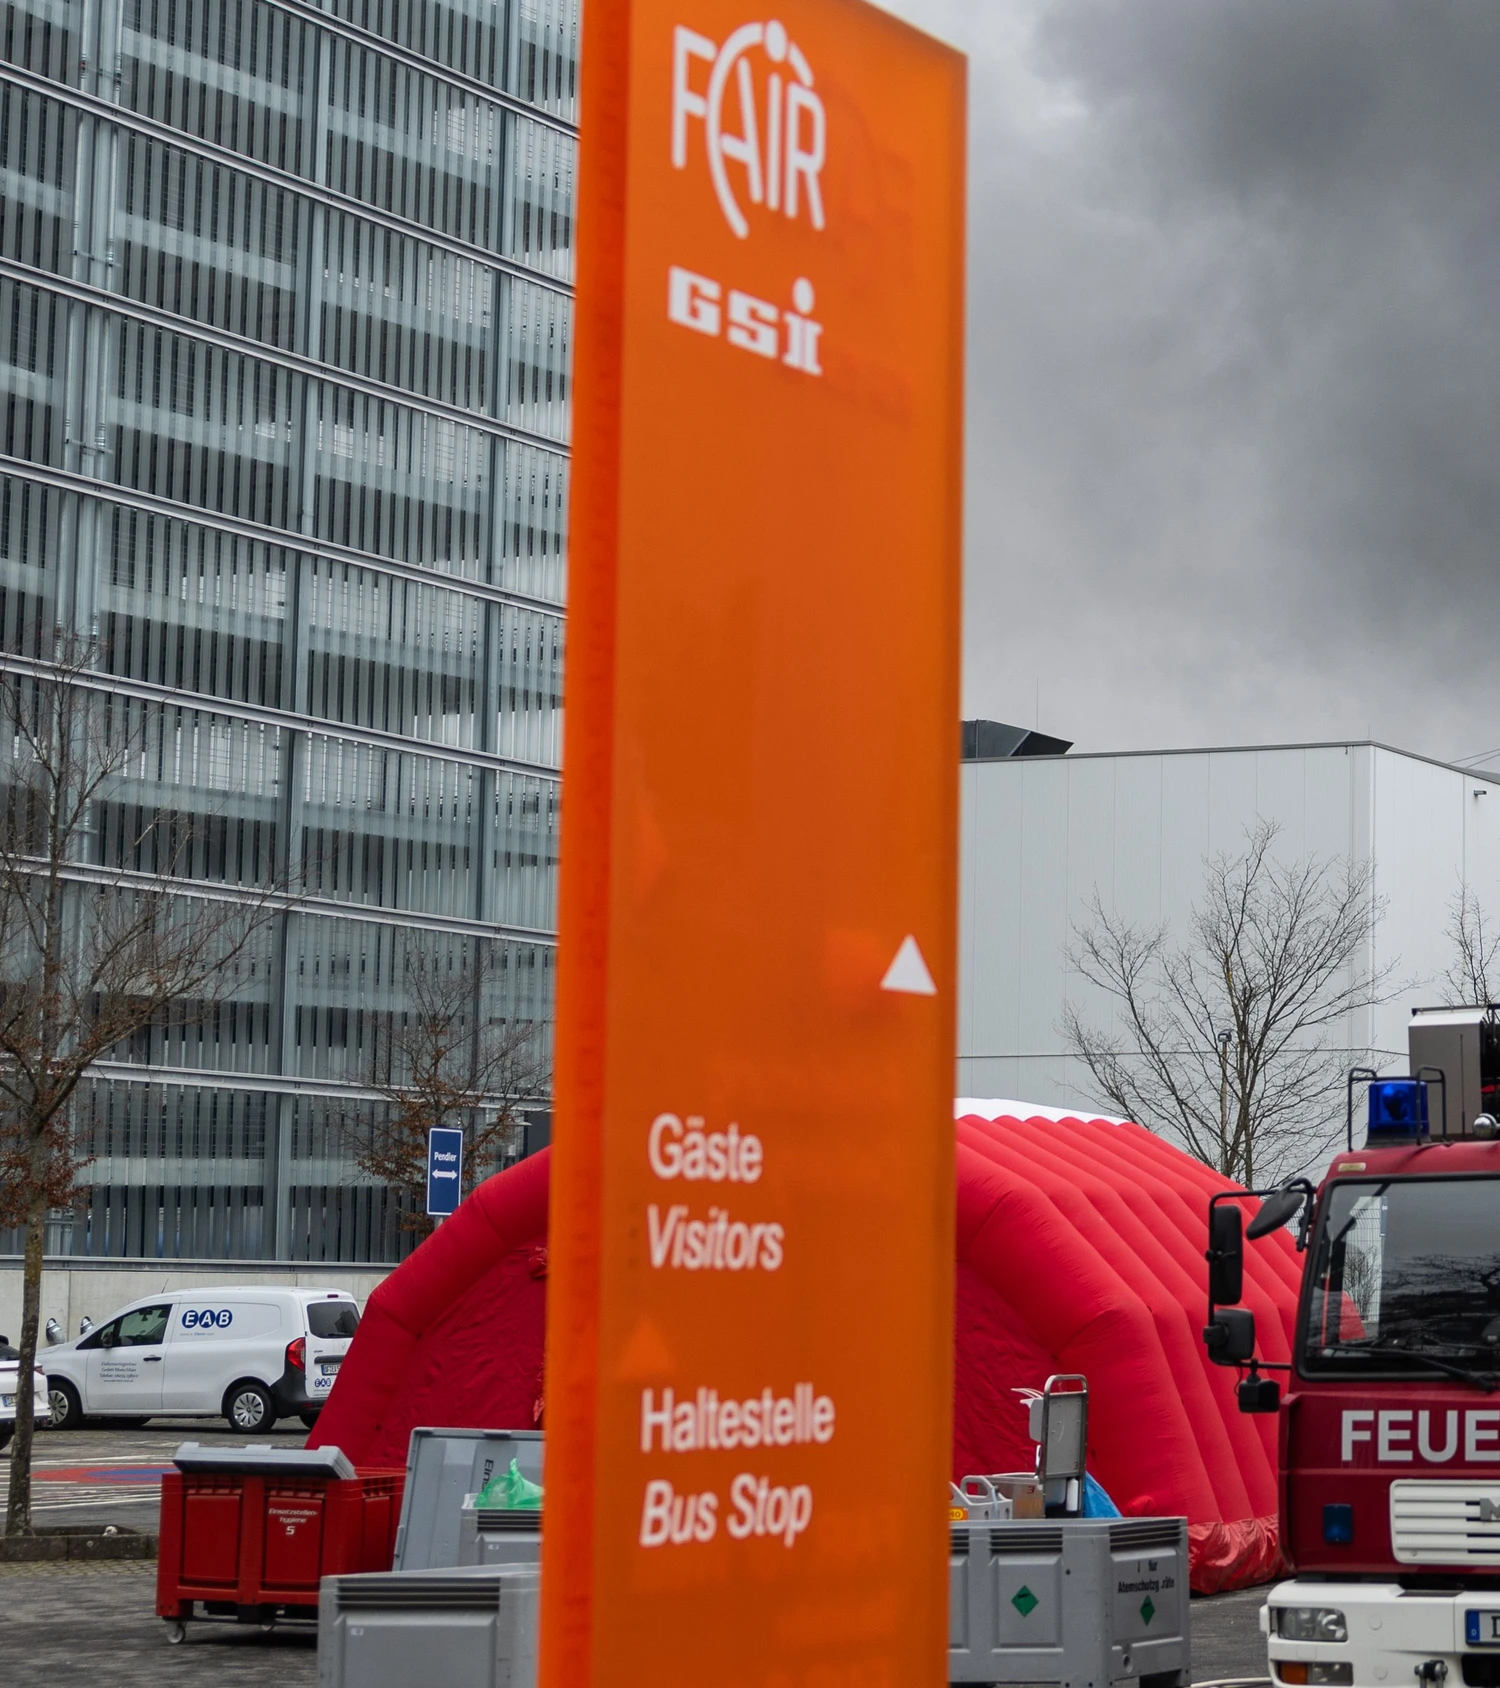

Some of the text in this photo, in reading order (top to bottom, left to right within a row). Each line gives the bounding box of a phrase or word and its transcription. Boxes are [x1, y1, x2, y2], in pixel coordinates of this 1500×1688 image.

[670, 18, 827, 240] FAIR
[434, 1151, 457, 1162] Pendler
[648, 1112, 763, 1184] Gäste
[647, 1203, 785, 1272] Visitors
[183, 1311, 231, 1327] EAB
[640, 1382, 835, 1454] Haltestelle
[639, 1472, 813, 1550] Bus Stop
